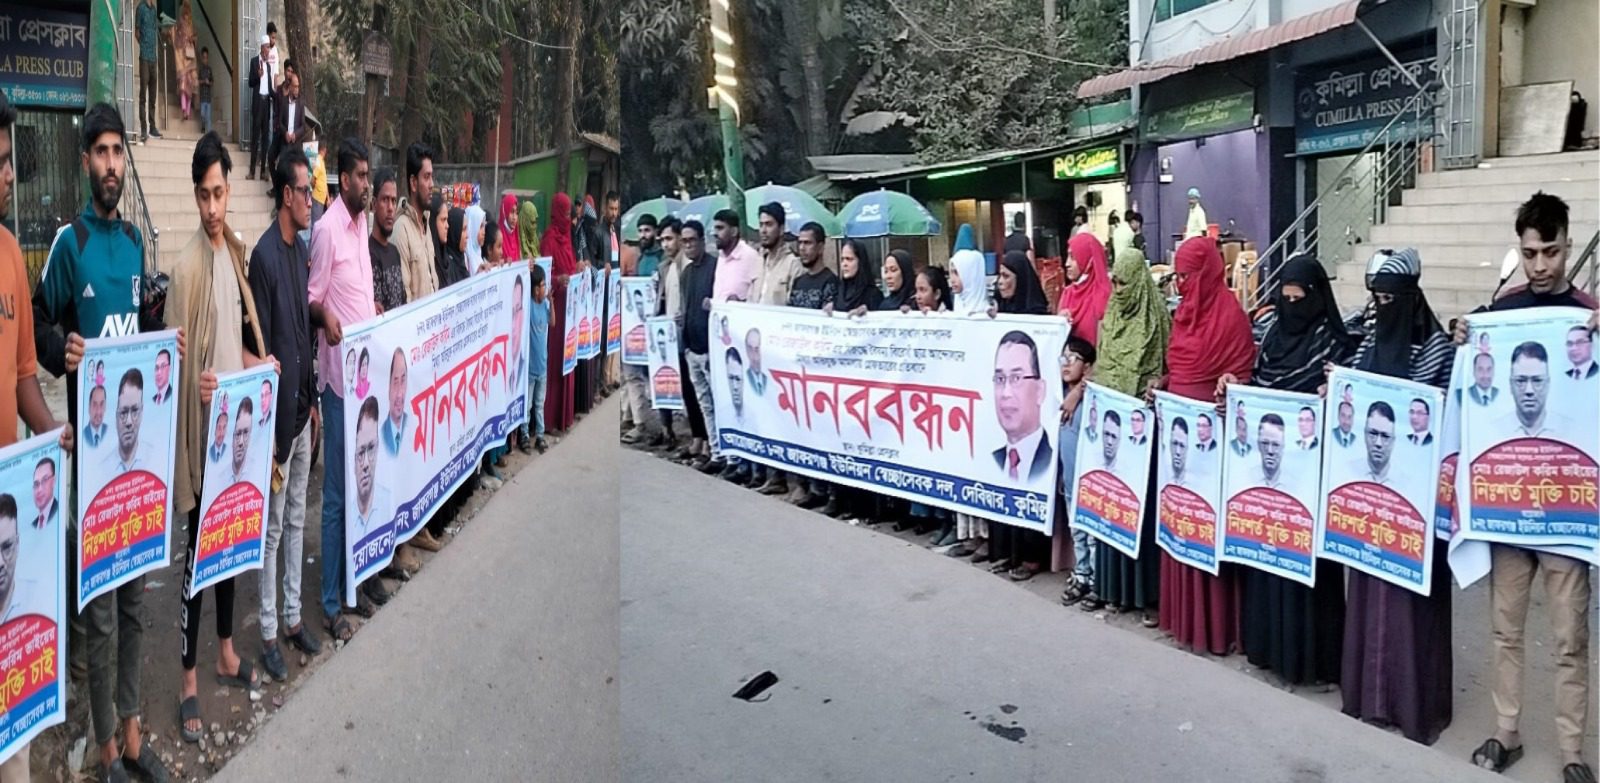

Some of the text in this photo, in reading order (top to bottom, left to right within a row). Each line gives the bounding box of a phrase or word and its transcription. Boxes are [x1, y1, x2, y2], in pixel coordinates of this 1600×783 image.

[19, 18, 87, 48] প্রেসক্লাব
[15, 55, 50, 76] PRESS
[54, 59, 84, 78] CLUB
[1315, 71, 1366, 105] কুমিল্লা
[1316, 106, 1364, 127] CUMILLA
[1366, 98, 1401, 119] PRESS
[1053, 156, 1077, 179] PC
[411, 334, 509, 464] মানববন্ধন
[768, 364, 983, 459] মানববন্ধন
[829, 452, 872, 480] ইউনিয়ন
[935, 479, 958, 502] দল,
[1472, 475, 1524, 503] নিঃশর্ত
[1526, 478, 1565, 510] মুক্তি
[1567, 479, 1598, 510] চাই
[83, 503, 165, 562] নিঃশর্ত মুক্তি চাই
[199, 511, 262, 556] নিঃশর্ত মুক্তি চাই
[1227, 511, 1312, 552] নিঃশর্ত মুক্তি চাই
[1328, 504, 1424, 560] নিঃশর্ত মুক্তি চাই
[29, 646, 56, 685] চাই
